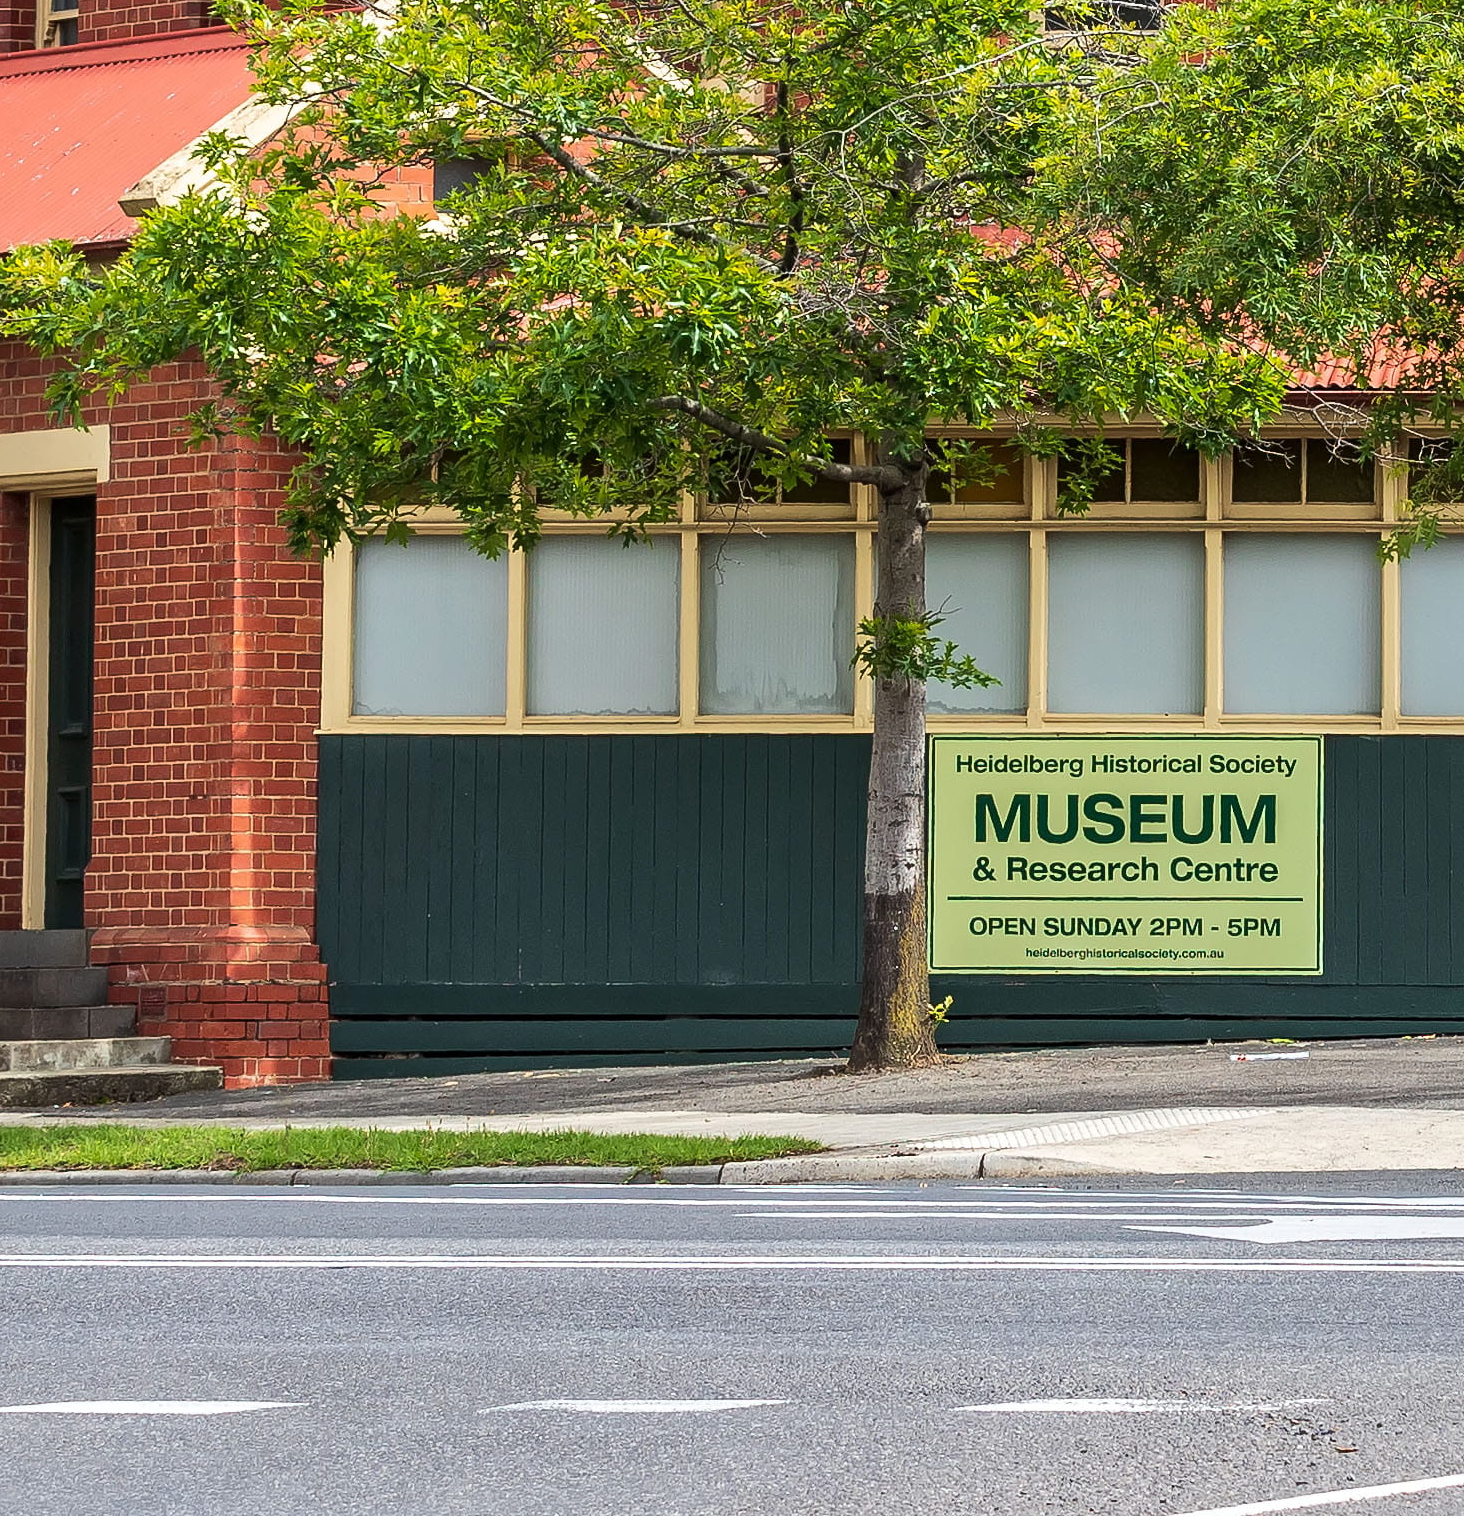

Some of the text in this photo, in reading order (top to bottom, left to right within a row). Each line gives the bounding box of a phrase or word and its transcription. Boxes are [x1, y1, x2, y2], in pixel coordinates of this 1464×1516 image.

[956, 755, 1297, 778] Heidelberg Historical Society
[975, 793, 1277, 845] MUSEUM
[972, 856, 1279, 883] & Research Centre
[969, 916, 1036, 937] OPEN
[1043, 917, 1142, 937] SUNDAY
[1149, 918, 1203, 937] 2PM
[1227, 918, 1281, 937] 5PM
[1025, 948, 1224, 961] heidelberghistoricalsociety.com.au
